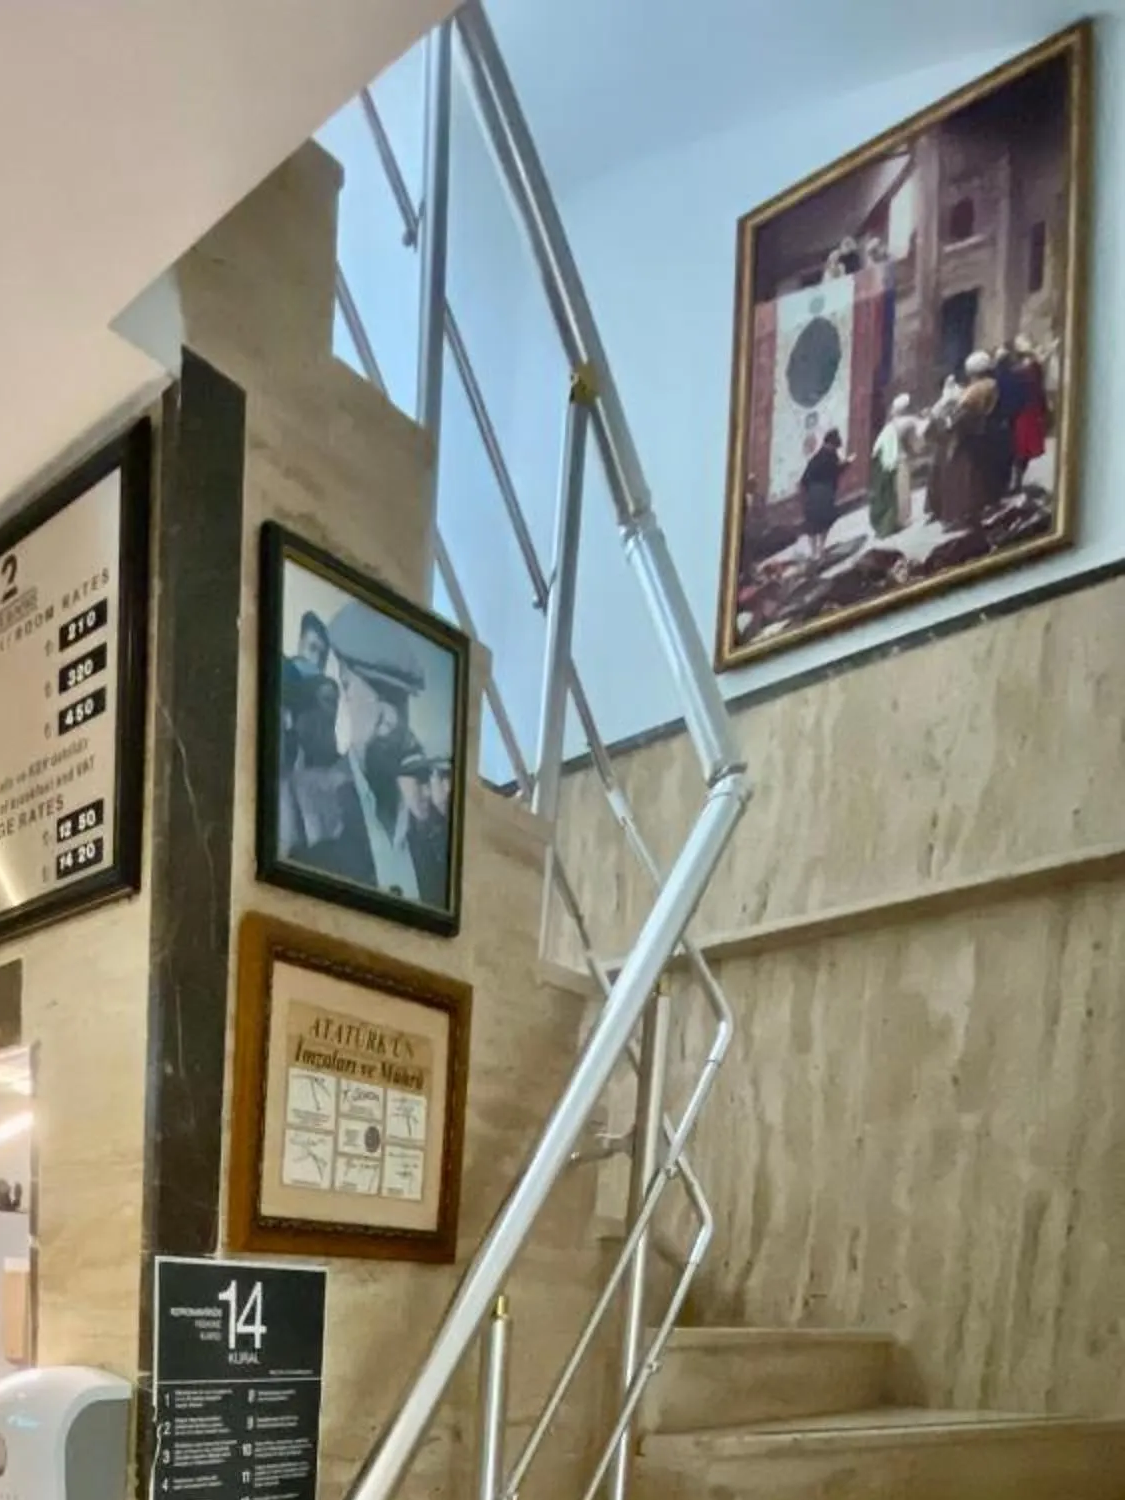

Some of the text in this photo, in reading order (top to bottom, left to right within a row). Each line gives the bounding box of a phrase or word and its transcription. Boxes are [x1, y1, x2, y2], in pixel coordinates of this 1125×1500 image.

[61, 568, 110, 609] RATES
[66, 611, 96, 641] 210
[67, 659, 94, 687] 320
[64, 698, 95, 726] 450
[18, 794, 64, 830] RATES
[218, 1279, 267, 1349] 14
